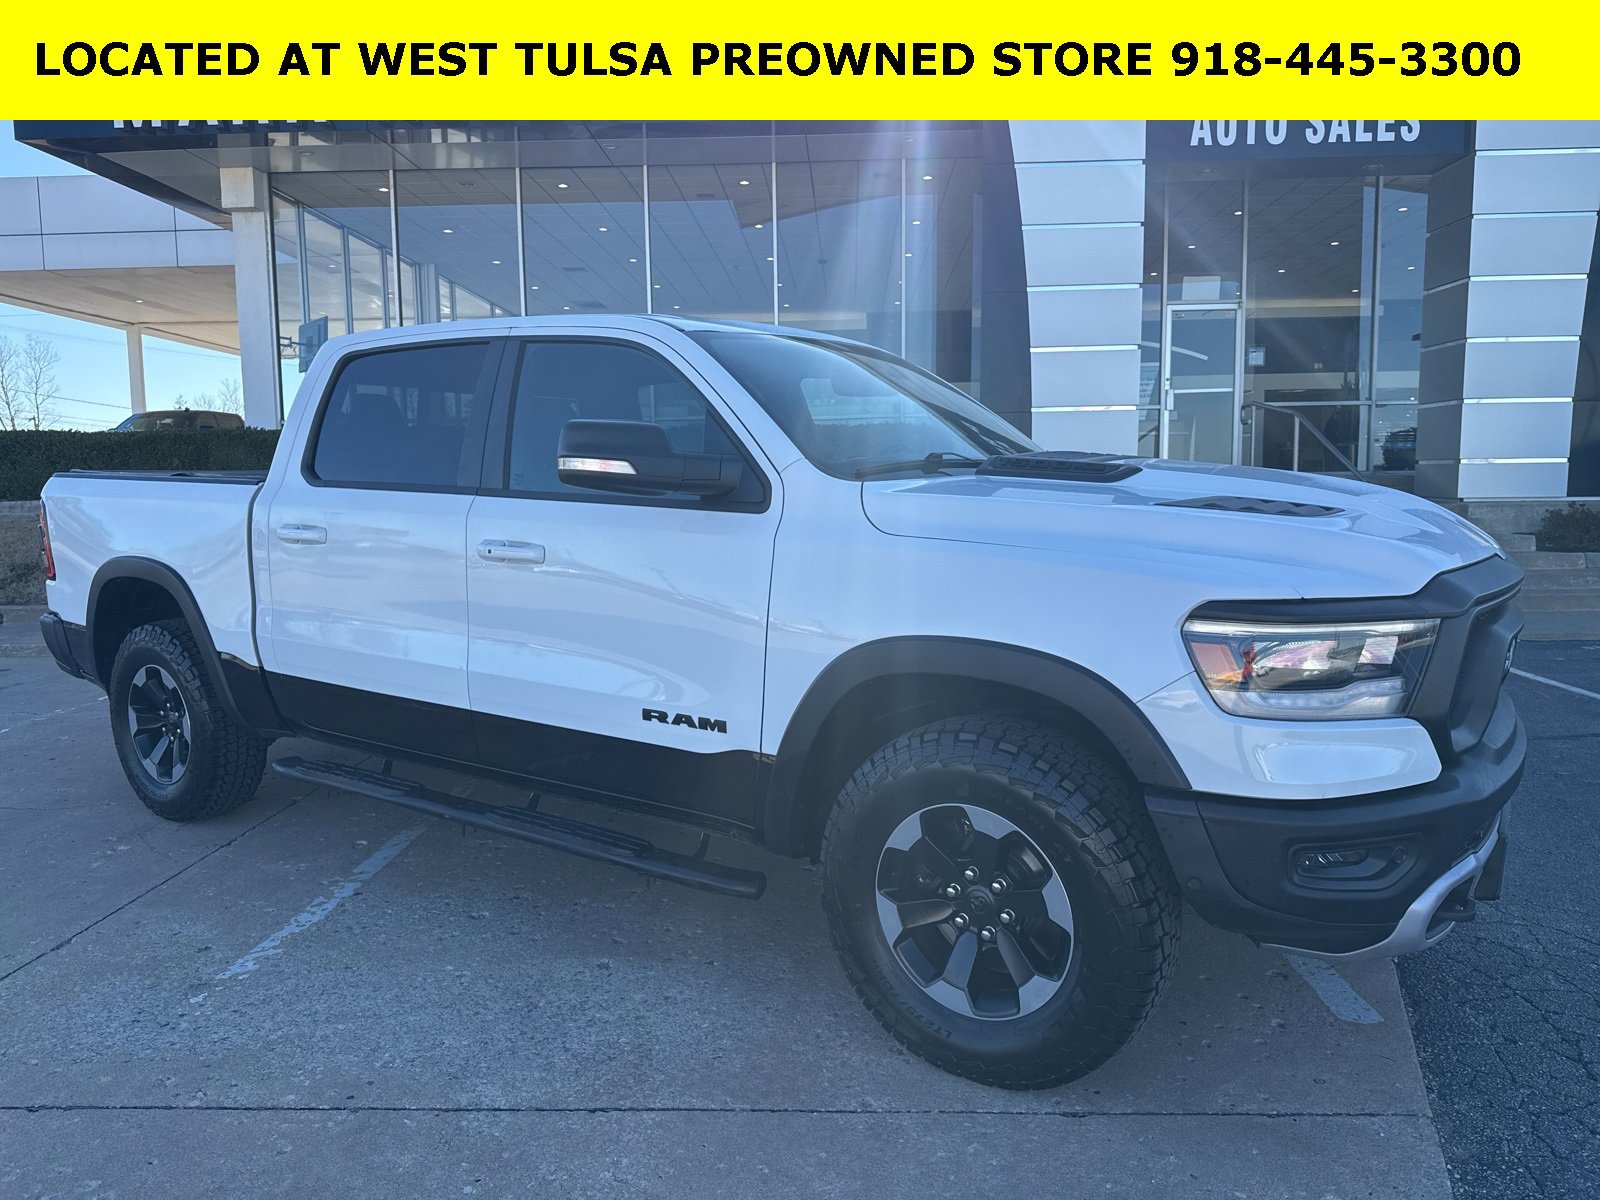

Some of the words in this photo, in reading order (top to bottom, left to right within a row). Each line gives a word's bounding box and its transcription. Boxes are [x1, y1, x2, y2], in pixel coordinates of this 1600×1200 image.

[1190, 120, 1287, 146] AUTO
[1305, 120, 1421, 144] SALES
[642, 708, 727, 734] RAM
